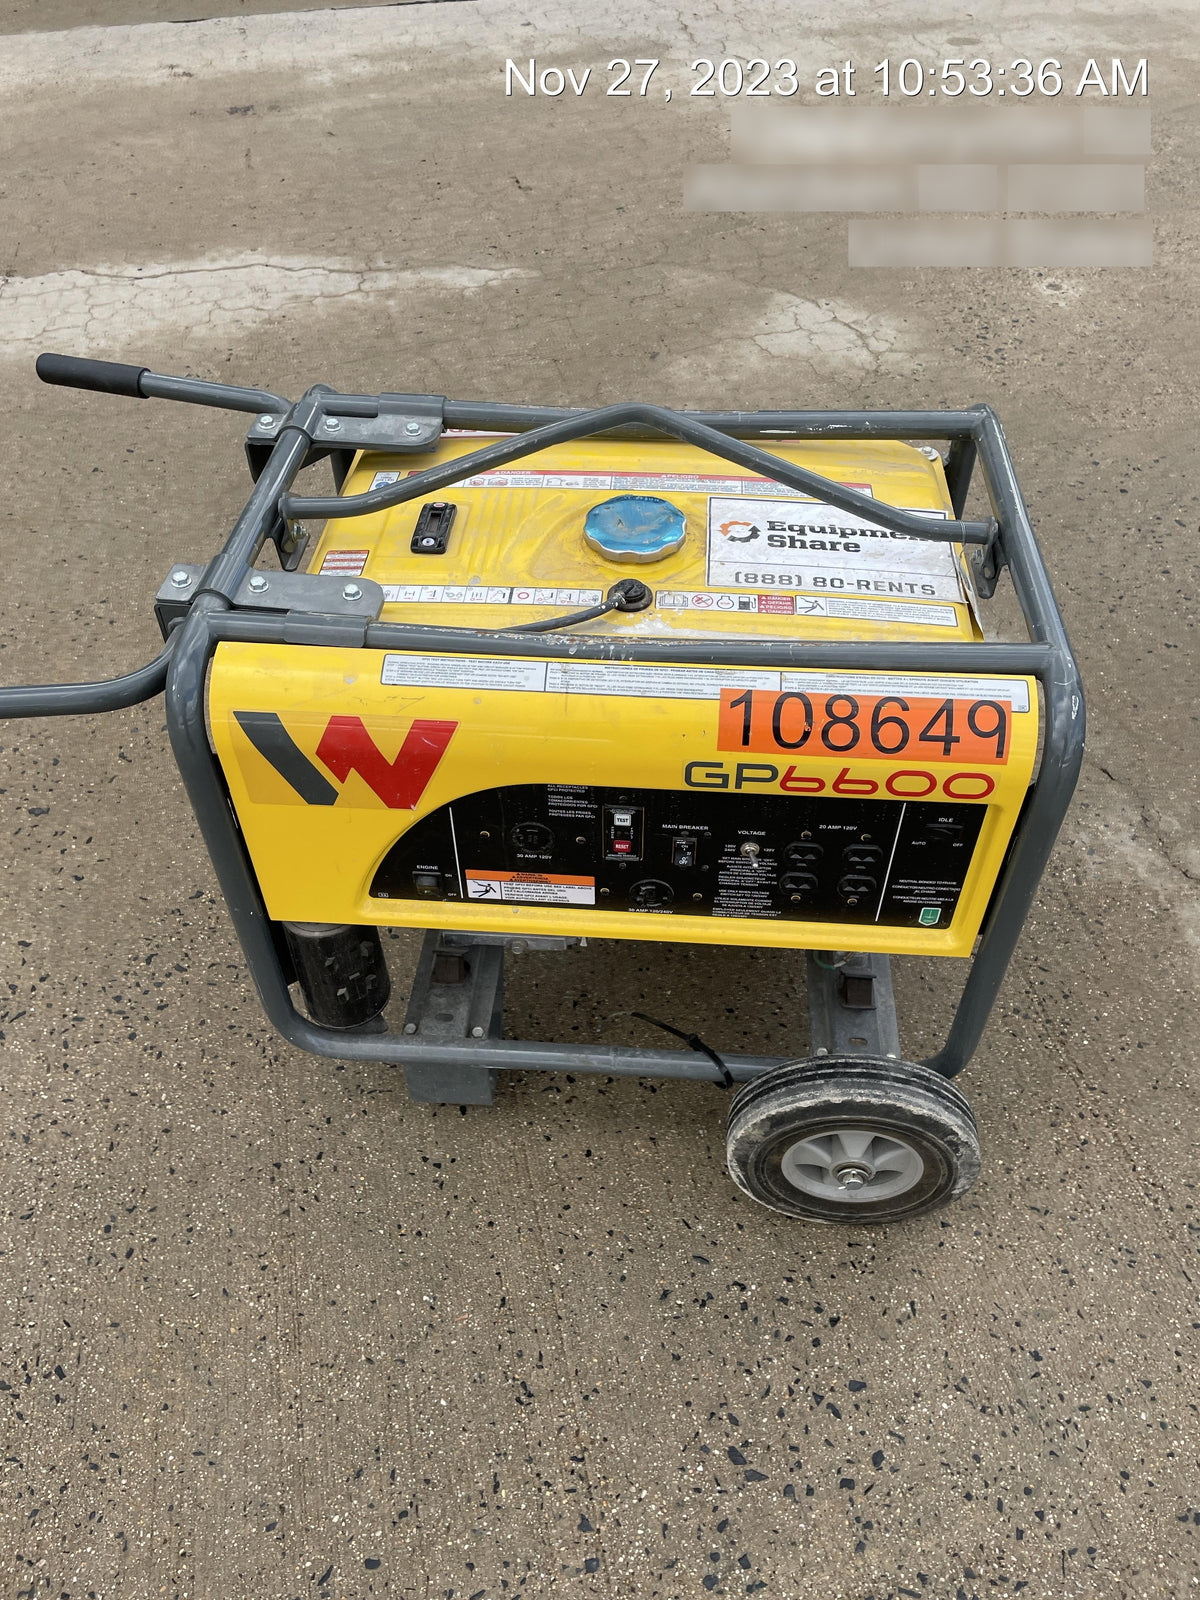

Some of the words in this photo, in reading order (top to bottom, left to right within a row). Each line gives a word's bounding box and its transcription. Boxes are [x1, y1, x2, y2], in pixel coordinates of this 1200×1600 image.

[767, 520, 928, 541] Equipme
[767, 534, 861, 553] Share
[735, 572, 802, 586] (888)
[813, 576, 936, 596] 80-RENTS
[729, 689, 1009, 759] 108649
[684, 761, 995, 798] GP6600
